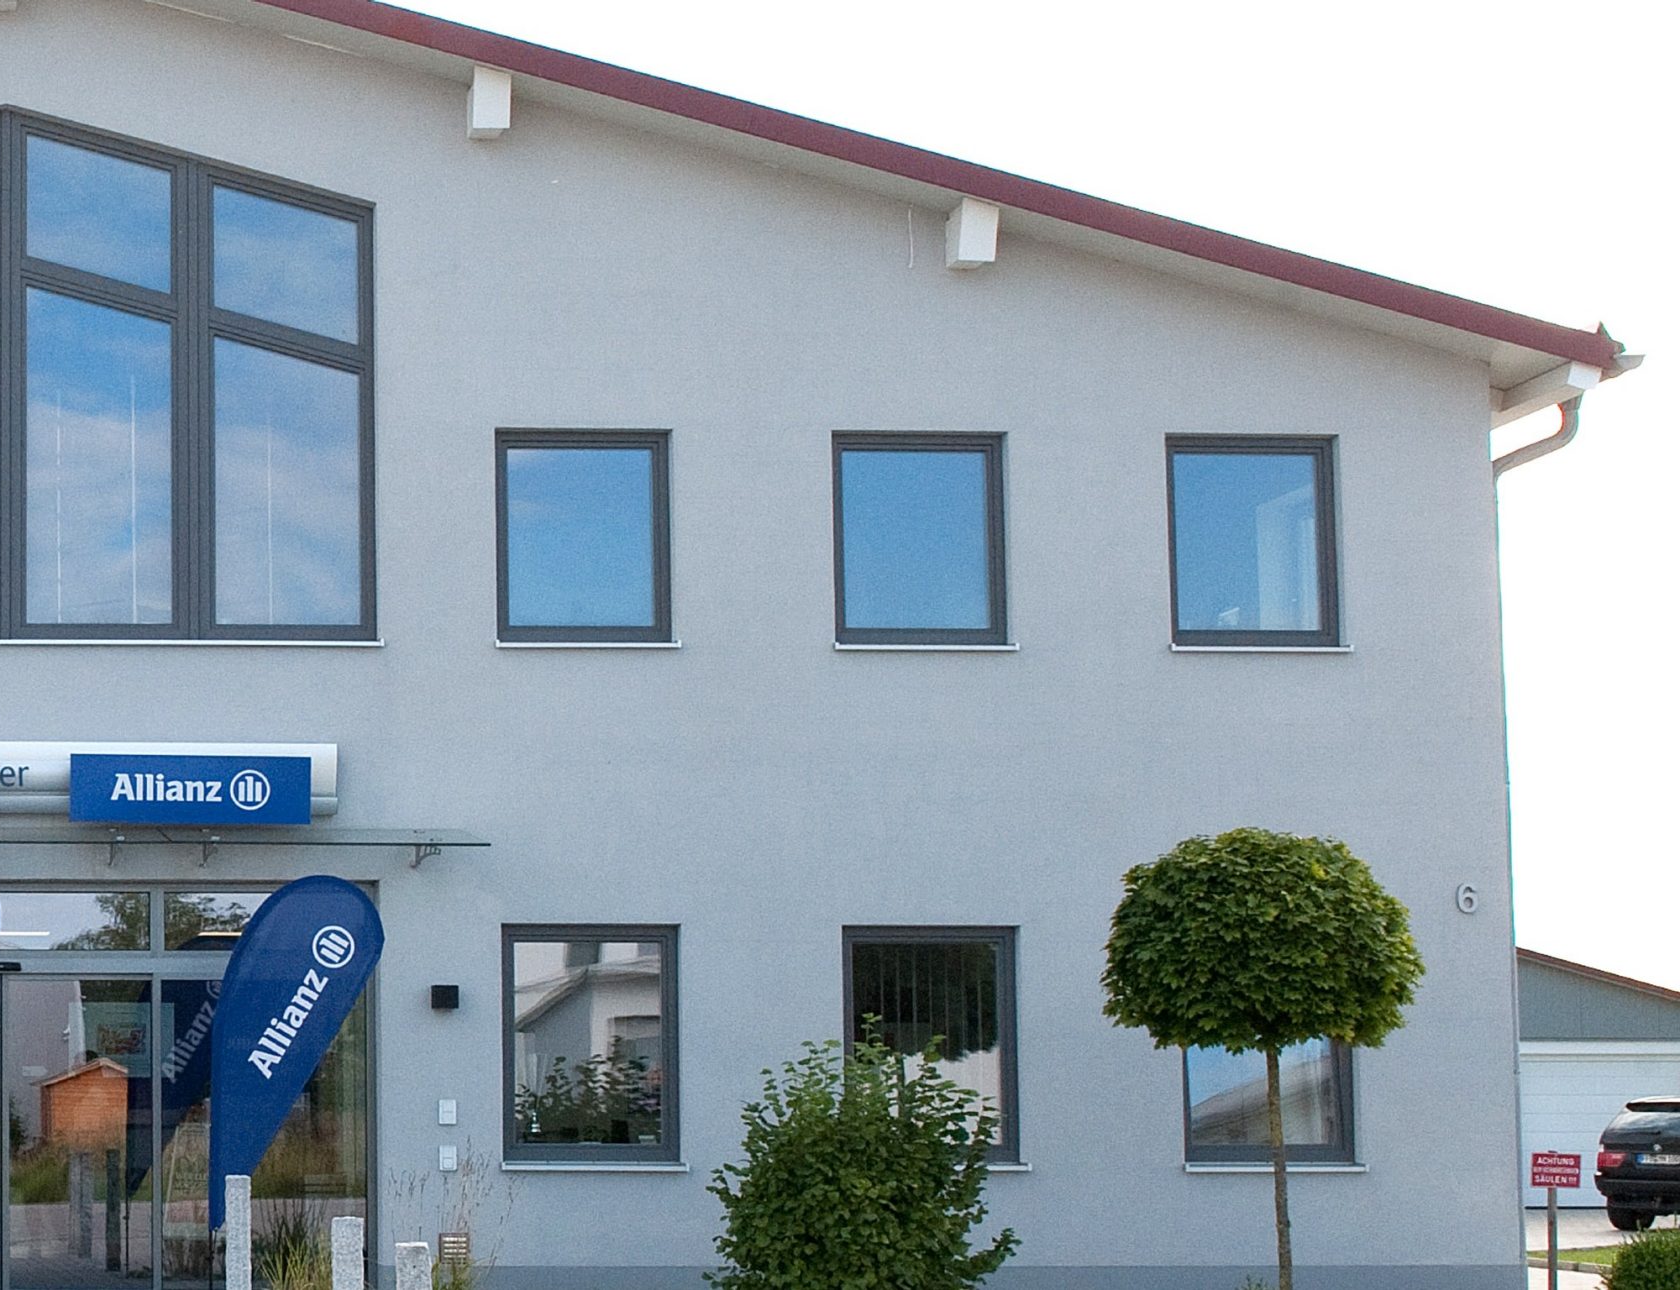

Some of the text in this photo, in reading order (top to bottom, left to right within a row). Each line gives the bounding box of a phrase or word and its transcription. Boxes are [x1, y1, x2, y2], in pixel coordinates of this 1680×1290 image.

[110, 773, 222, 802] Allianz
[1455, 883, 1479, 915] 6
[247, 968, 329, 1080] Allianz
[161, 1001, 217, 1084] Allianz
[1536, 1156, 1575, 1166] ACHTUNG
